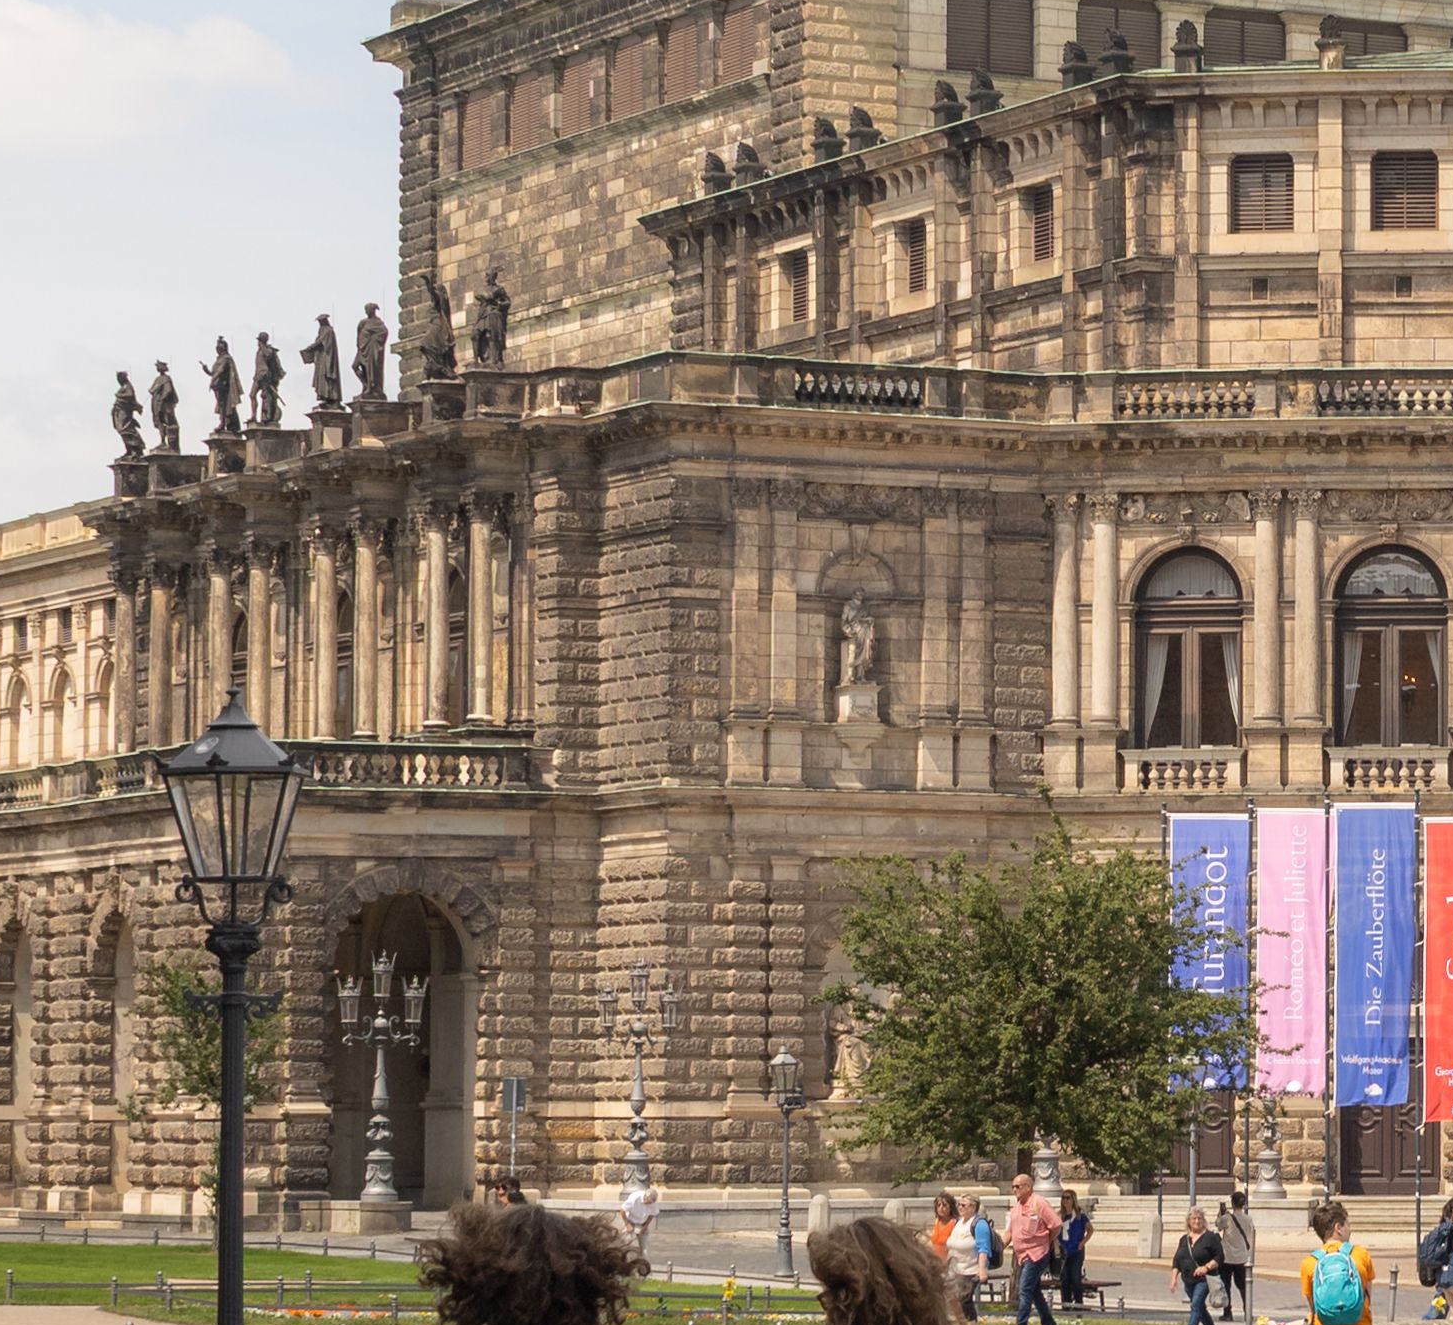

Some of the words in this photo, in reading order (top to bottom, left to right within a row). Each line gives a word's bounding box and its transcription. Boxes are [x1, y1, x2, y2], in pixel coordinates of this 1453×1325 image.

[1283, 824, 1309, 903] Juliette
[1193, 845, 1229, 994] Turndot
[1291, 914, 1306, 933] et
[1365, 848, 1386, 979] Zauberflöte
[1283, 940, 1305, 1020] Roméo
[1365, 987, 1382, 1026] Die
